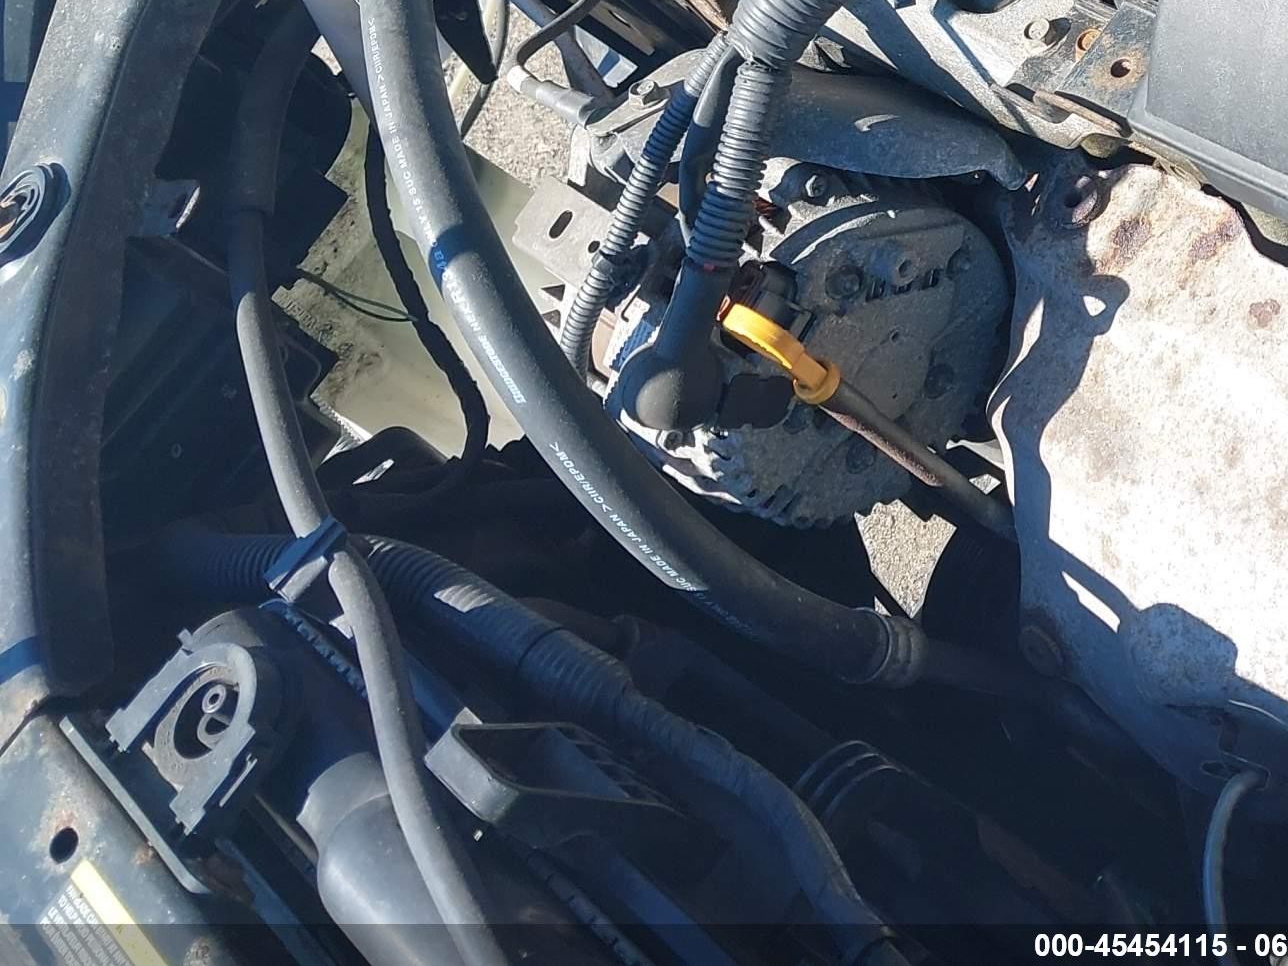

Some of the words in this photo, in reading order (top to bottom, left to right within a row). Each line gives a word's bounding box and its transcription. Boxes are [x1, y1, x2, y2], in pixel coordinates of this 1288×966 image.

[379, 84, 394, 120] JAPAN
[388, 121, 398, 133] IN
[392, 136, 408, 168] MADE
[609, 514, 642, 542] JAPAN
[639, 543, 653, 555] IN
[650, 554, 679, 577] MADE
